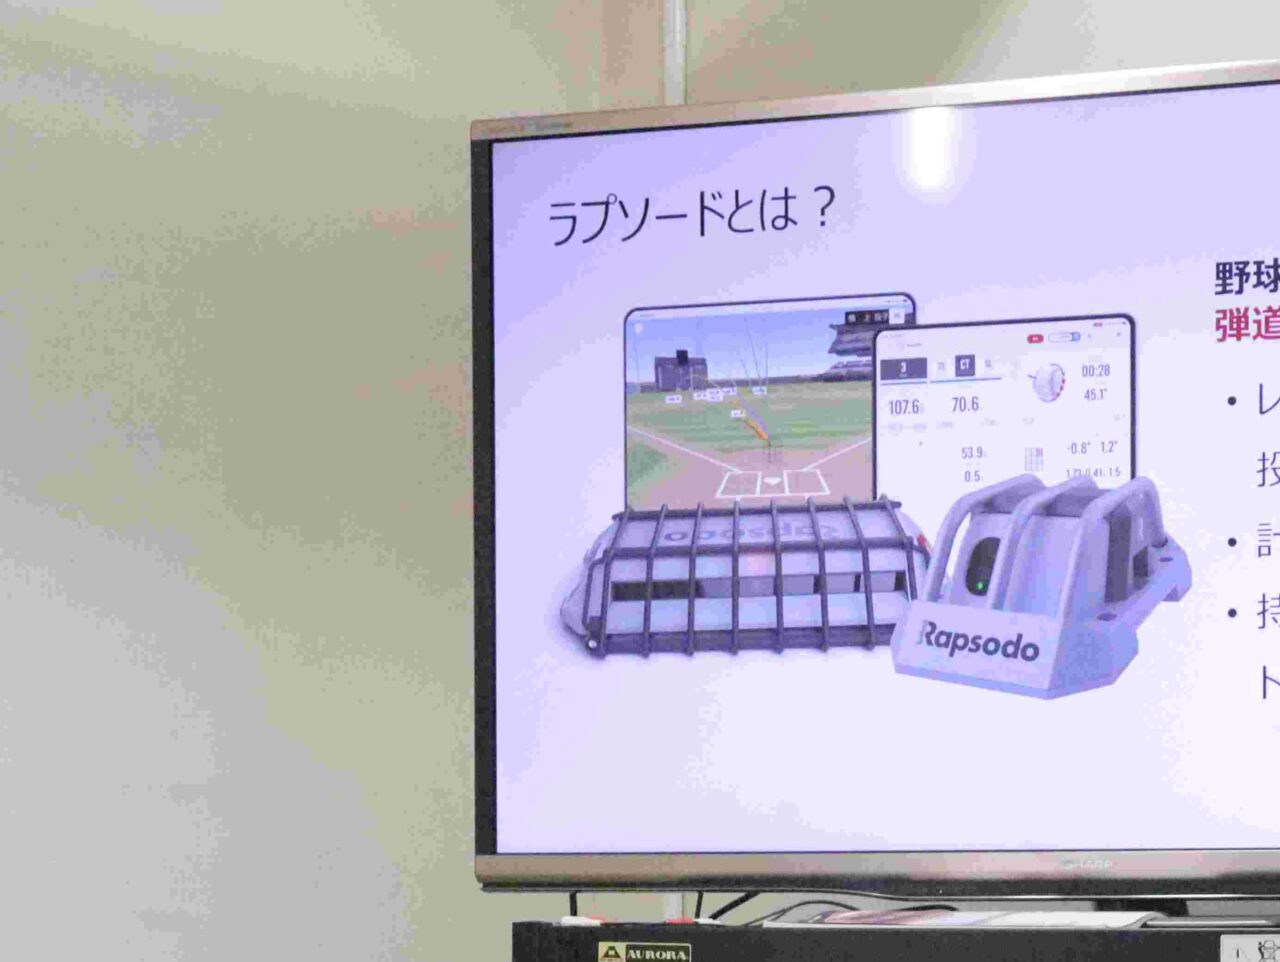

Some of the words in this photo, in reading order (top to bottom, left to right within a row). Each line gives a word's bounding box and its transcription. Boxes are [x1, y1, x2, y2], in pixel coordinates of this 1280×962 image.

[549, 185, 836, 247] ラプソードとは？
[952, 396, 980, 413] 70.6
[916, 619, 1040, 662] Rapsodo
[626, 949, 687, 961] AURORA
